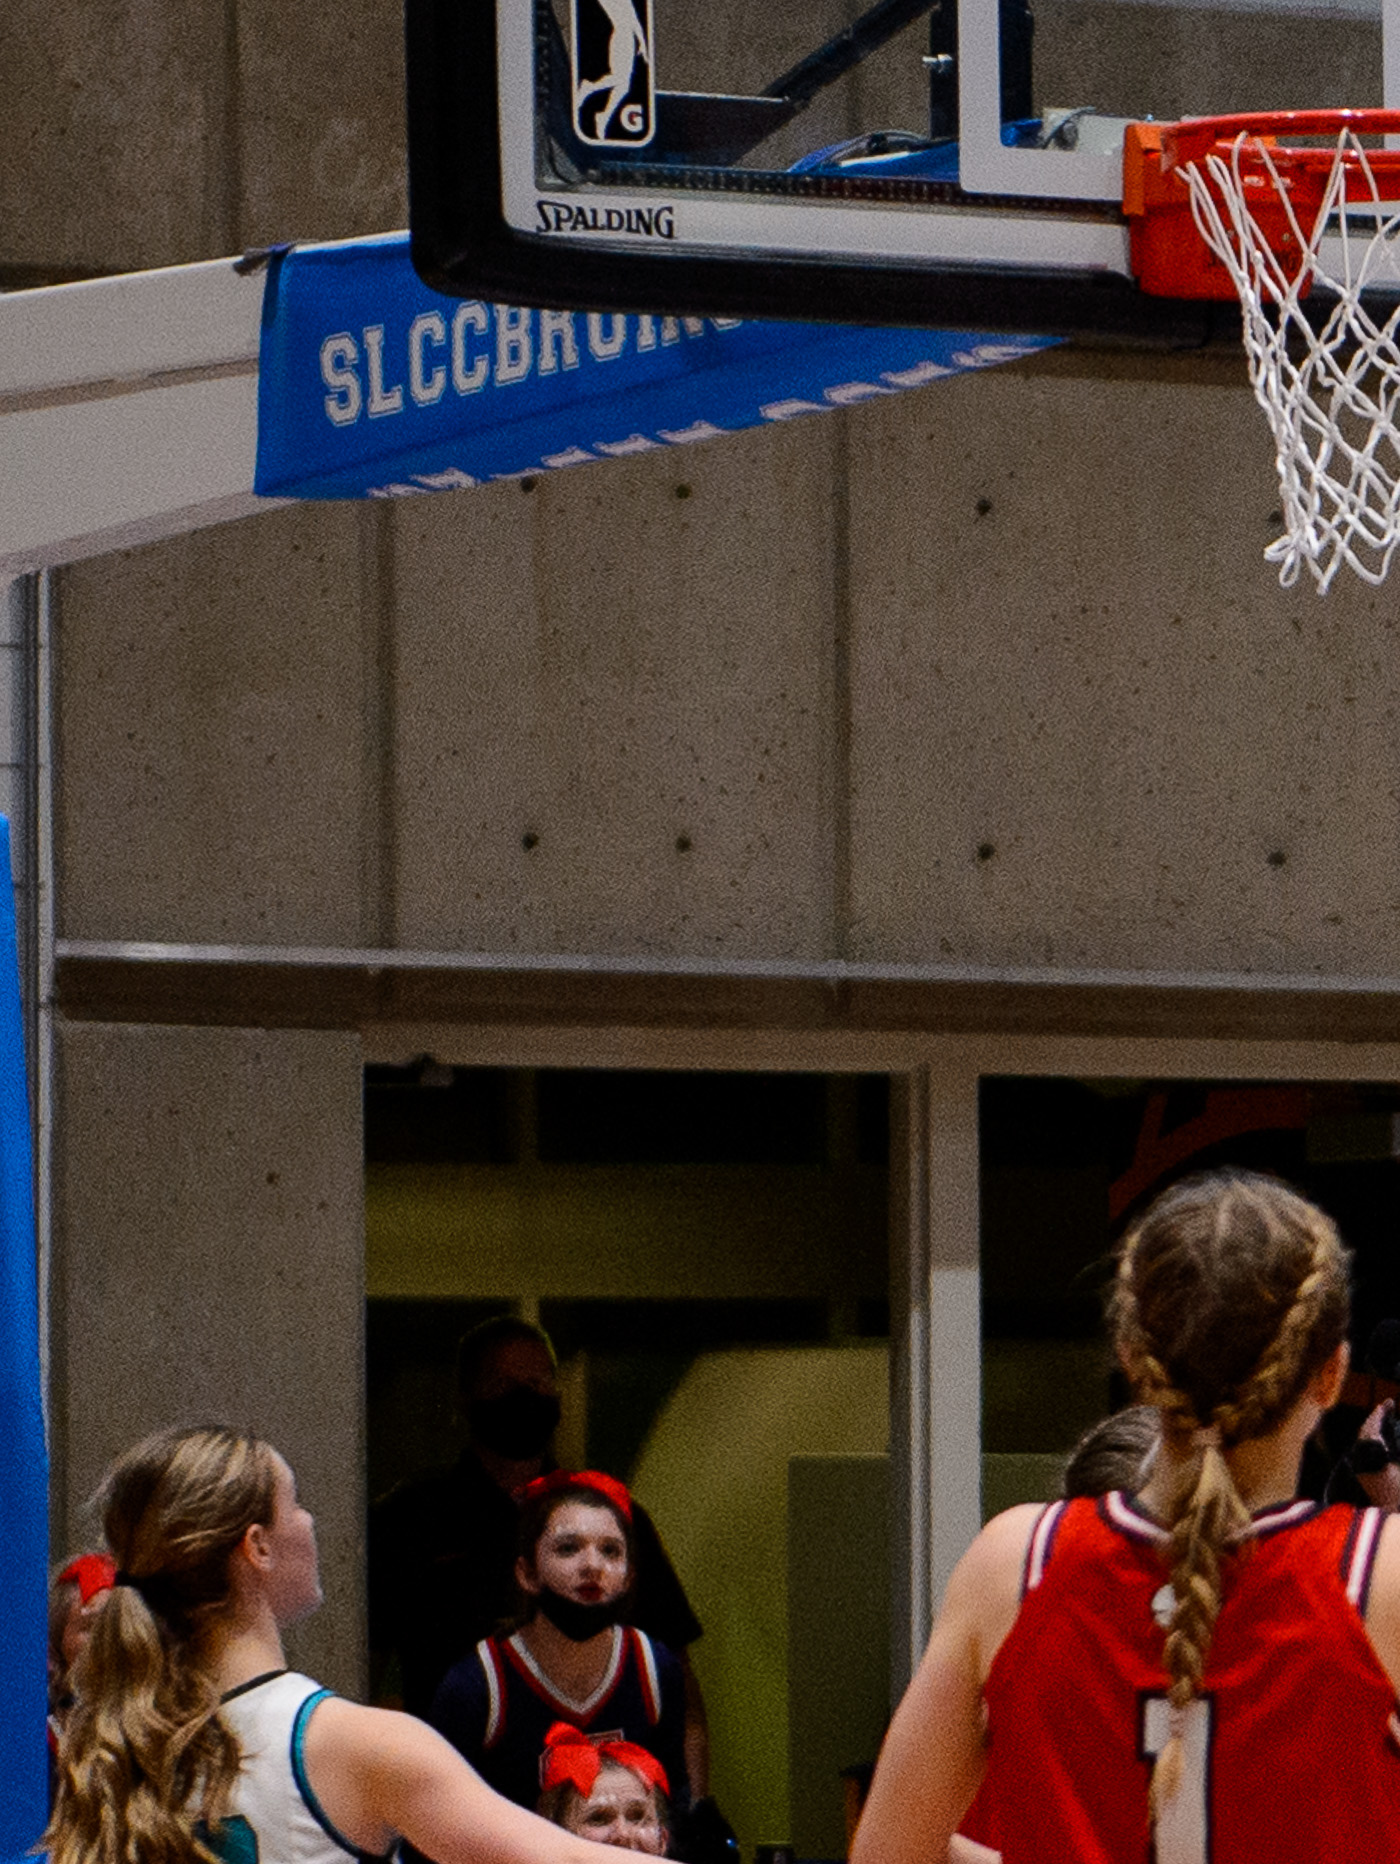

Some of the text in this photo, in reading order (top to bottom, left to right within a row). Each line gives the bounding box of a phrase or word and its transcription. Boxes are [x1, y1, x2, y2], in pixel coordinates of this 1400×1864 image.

[619, 103, 644, 133] G
[536, 200, 676, 239] SPALDING
[318, 300, 742, 428] SLCCBRU
